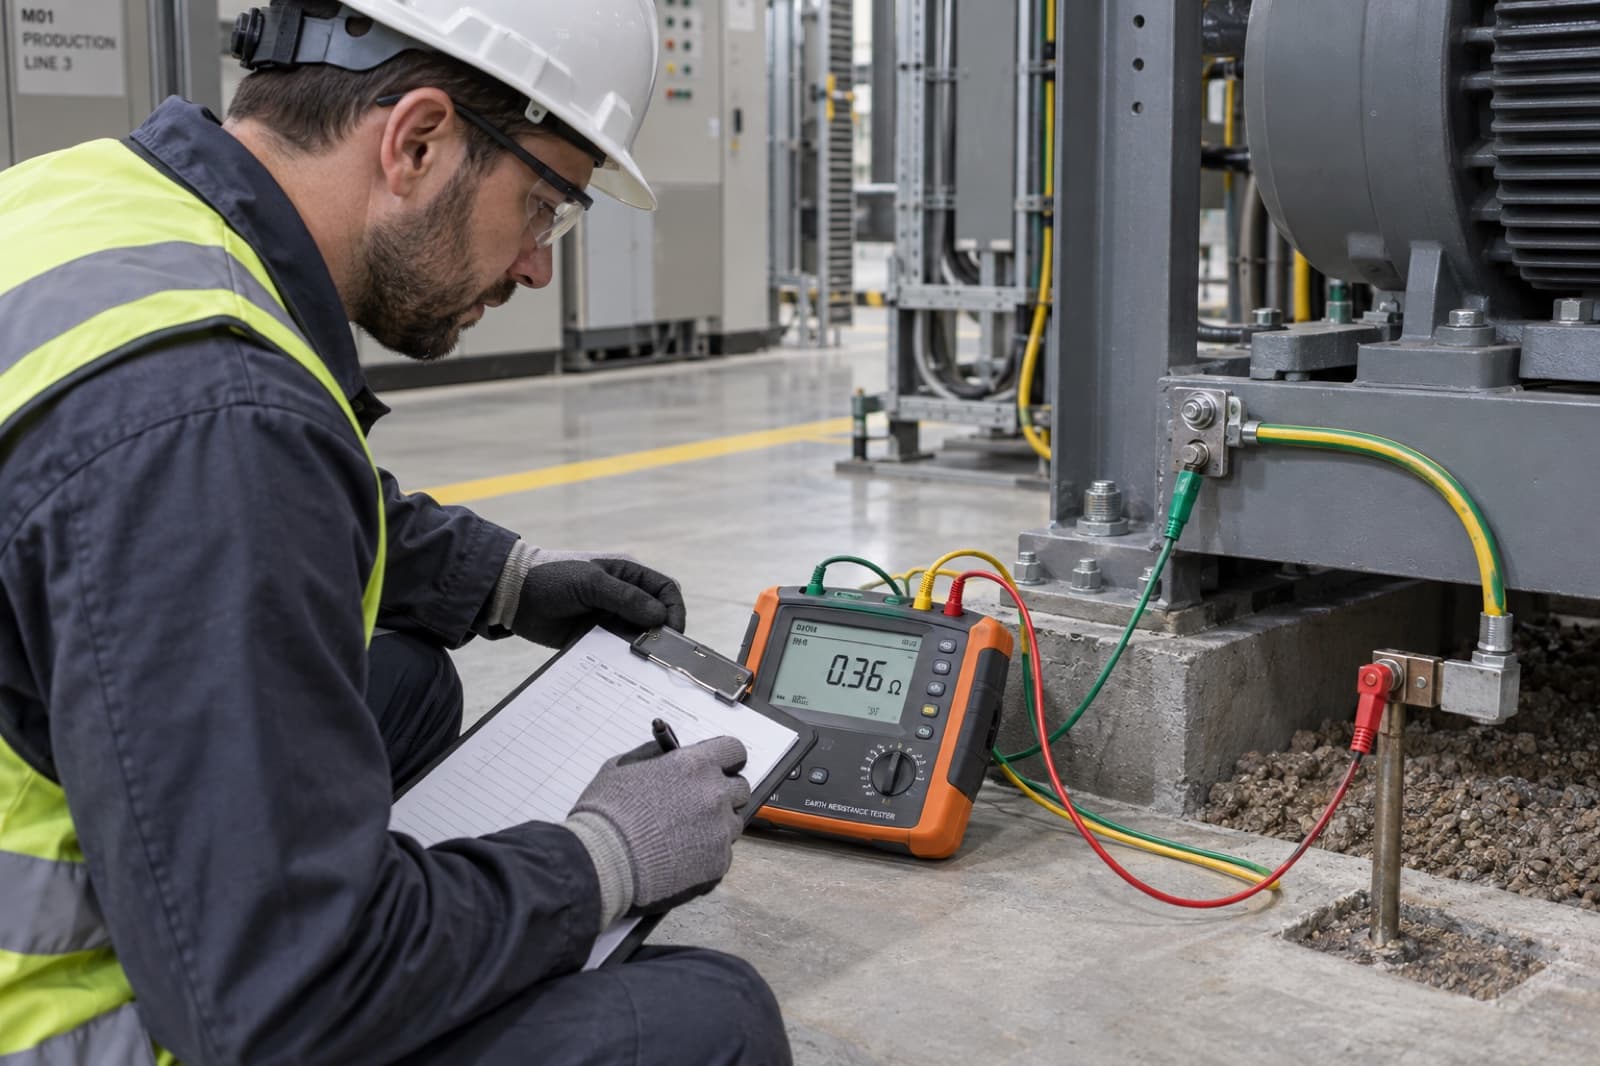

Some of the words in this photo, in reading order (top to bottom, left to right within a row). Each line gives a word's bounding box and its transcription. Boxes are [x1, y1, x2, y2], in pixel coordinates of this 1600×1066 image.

[23, 31, 117, 50] PRODUCTION
[24, 56, 58, 72] LINE
[62, 56, 73, 72] 3
[826, 654, 887, 692] 0.36
[804, 799, 827, 809] EARTH
[828, 803, 869, 816] RESISTANCE
[870, 810, 896, 820] TESTER
